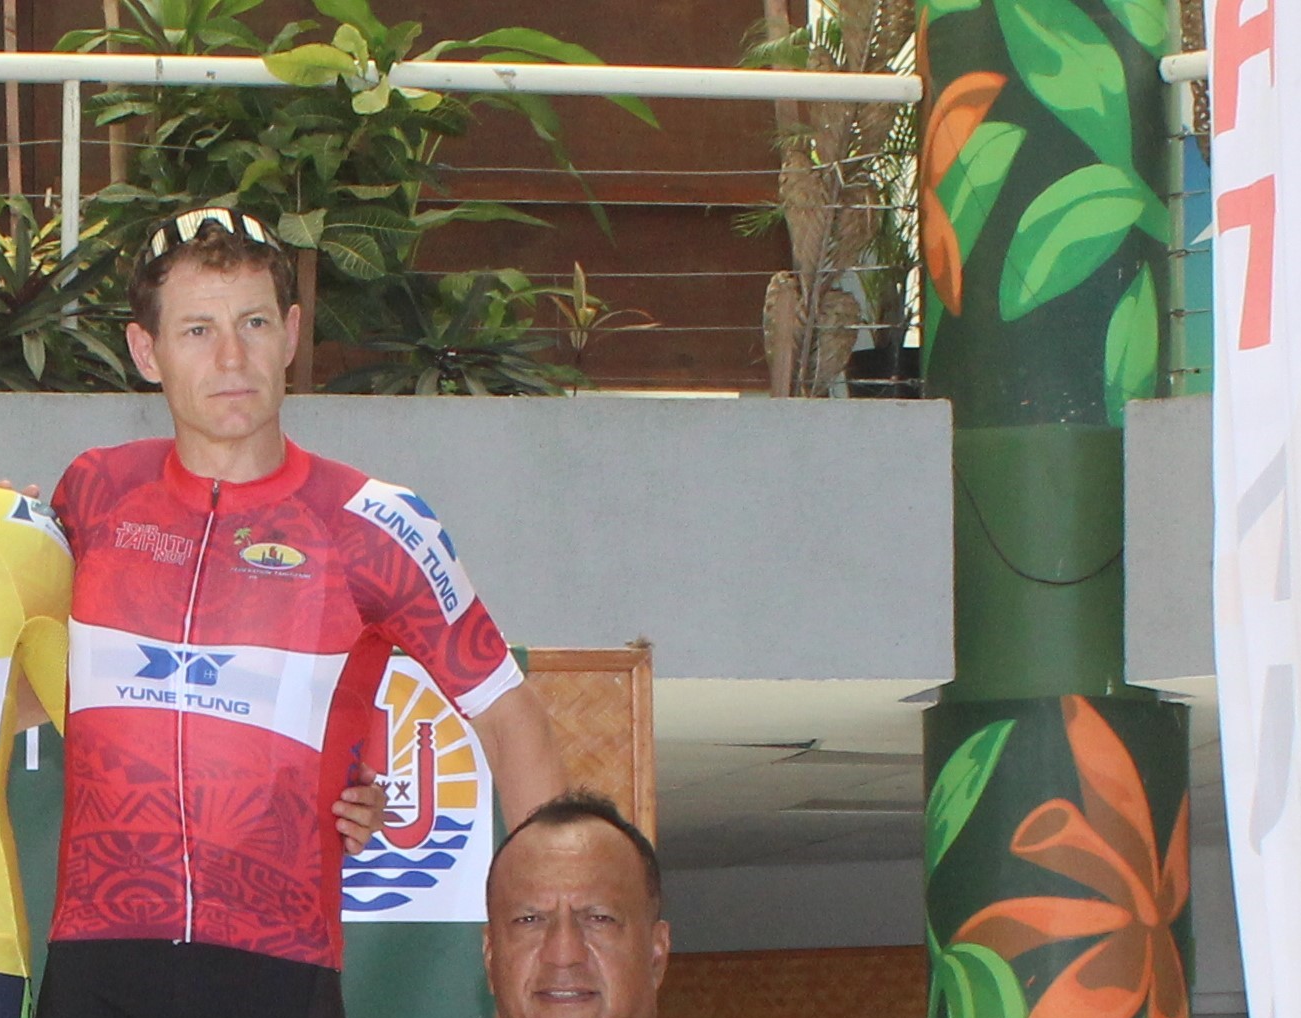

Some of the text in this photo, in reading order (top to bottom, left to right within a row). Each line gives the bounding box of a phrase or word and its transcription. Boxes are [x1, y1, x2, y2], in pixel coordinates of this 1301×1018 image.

[114, 528, 194, 557] TAHITI
[361, 498, 458, 613] YUNE TUNG
[116, 685, 251, 716] YUNE TUNG
